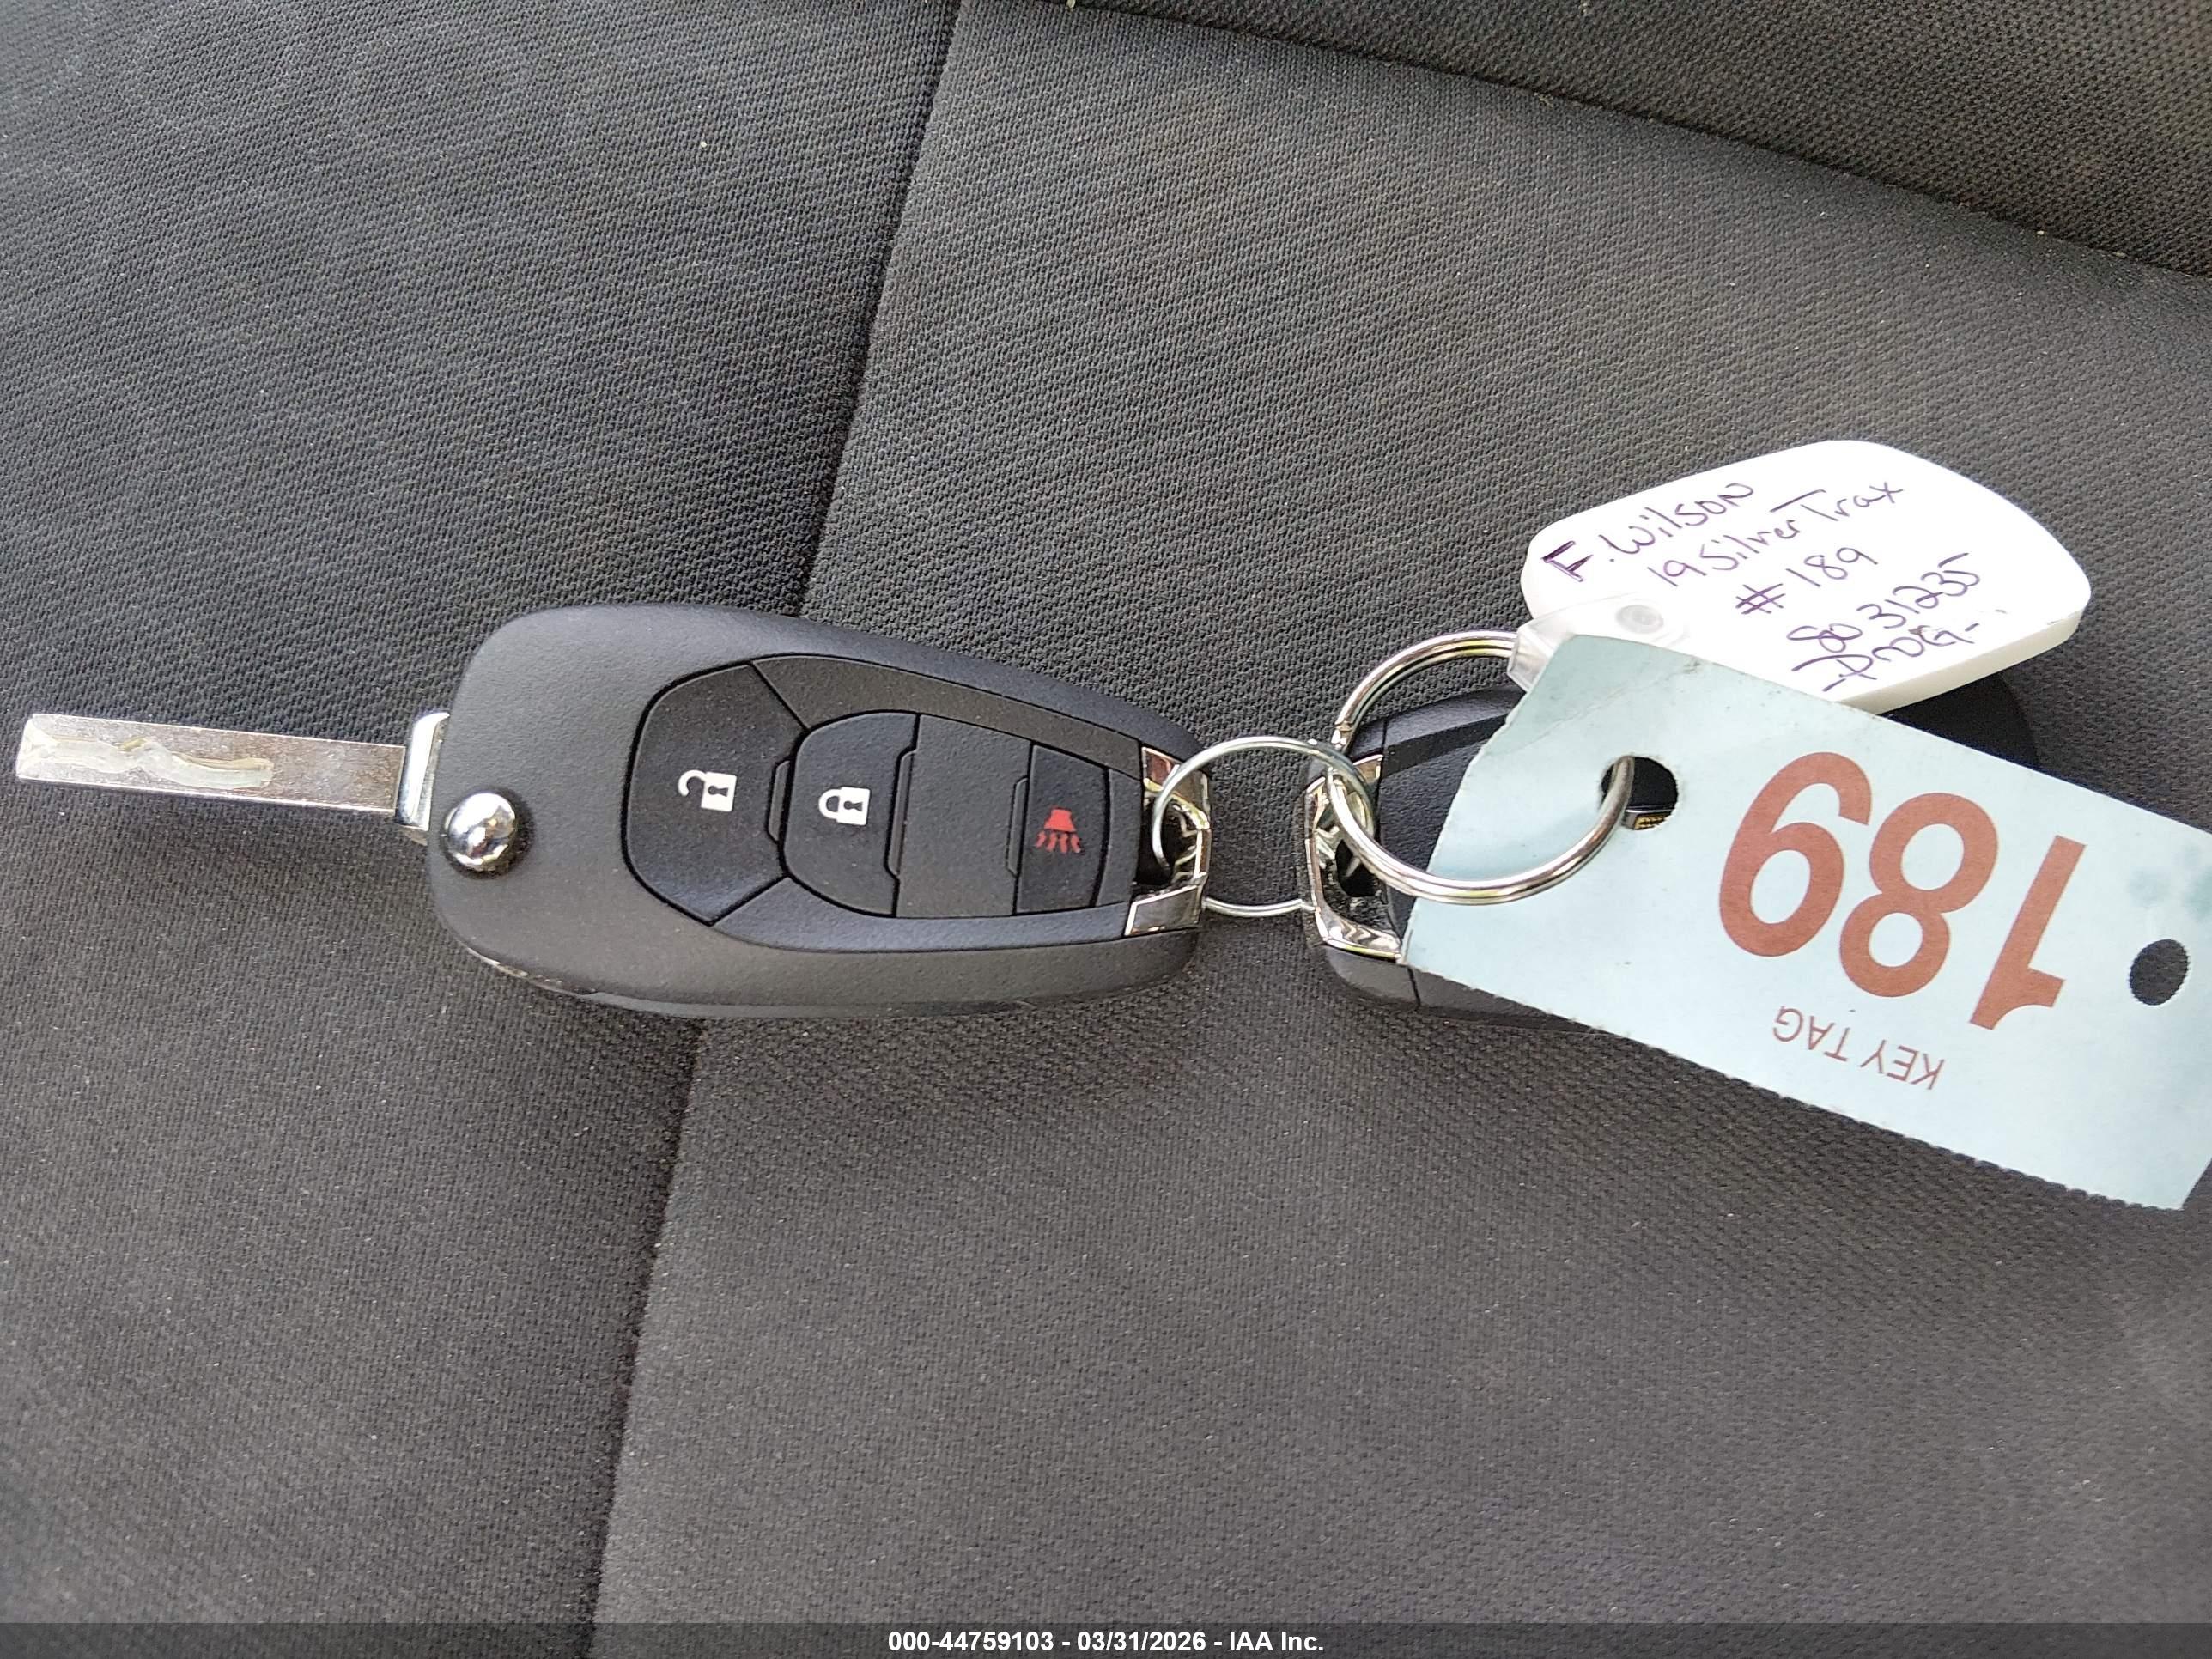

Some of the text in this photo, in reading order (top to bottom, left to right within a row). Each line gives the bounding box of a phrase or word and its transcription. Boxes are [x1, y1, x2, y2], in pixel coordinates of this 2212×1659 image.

[1769, 481, 1905, 522] Trax
[1719, 751, 2087, 1031] 189
[1771, 1005, 1946, 1091] KEY TAG
